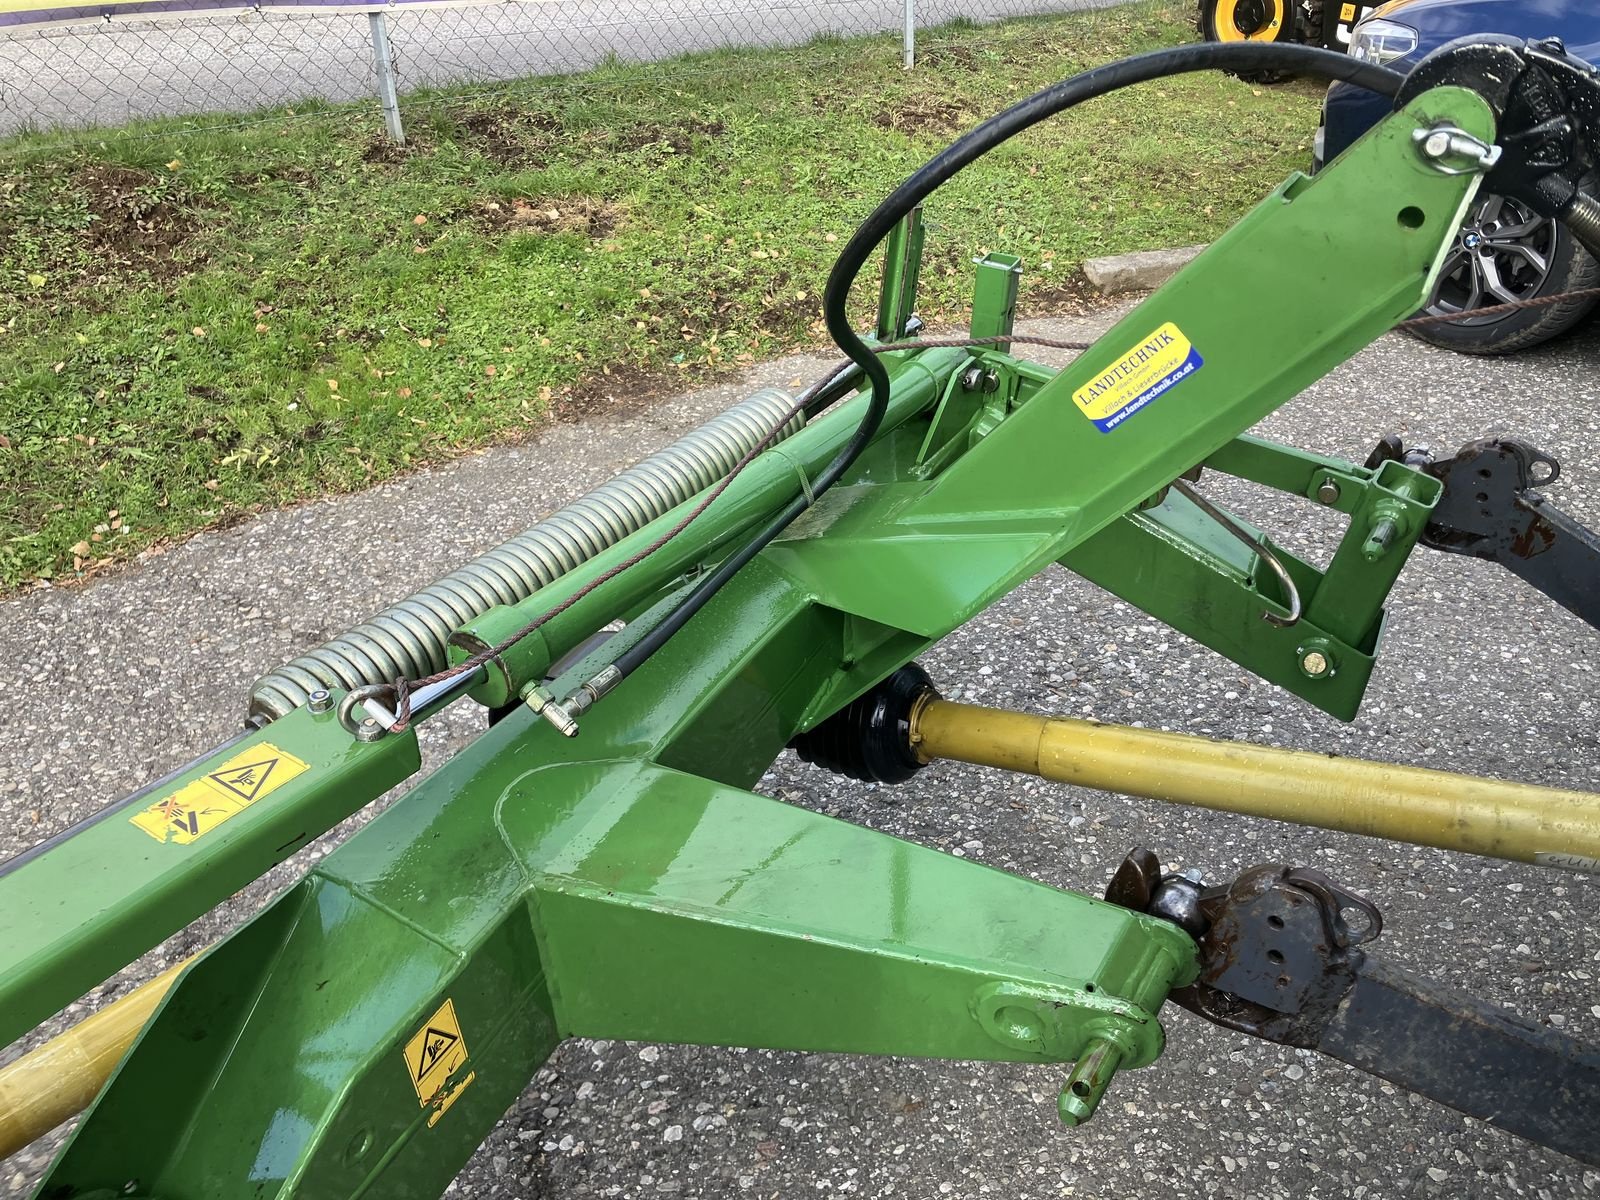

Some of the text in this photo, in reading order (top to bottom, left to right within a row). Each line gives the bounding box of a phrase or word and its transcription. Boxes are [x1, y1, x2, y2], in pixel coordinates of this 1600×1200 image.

[1079, 330, 1175, 406] LANDTECHNIK
[1102, 357, 1179, 415] Villach & Lieserbrücke
[1106, 362, 1195, 429] www.landtechnik.co.at
